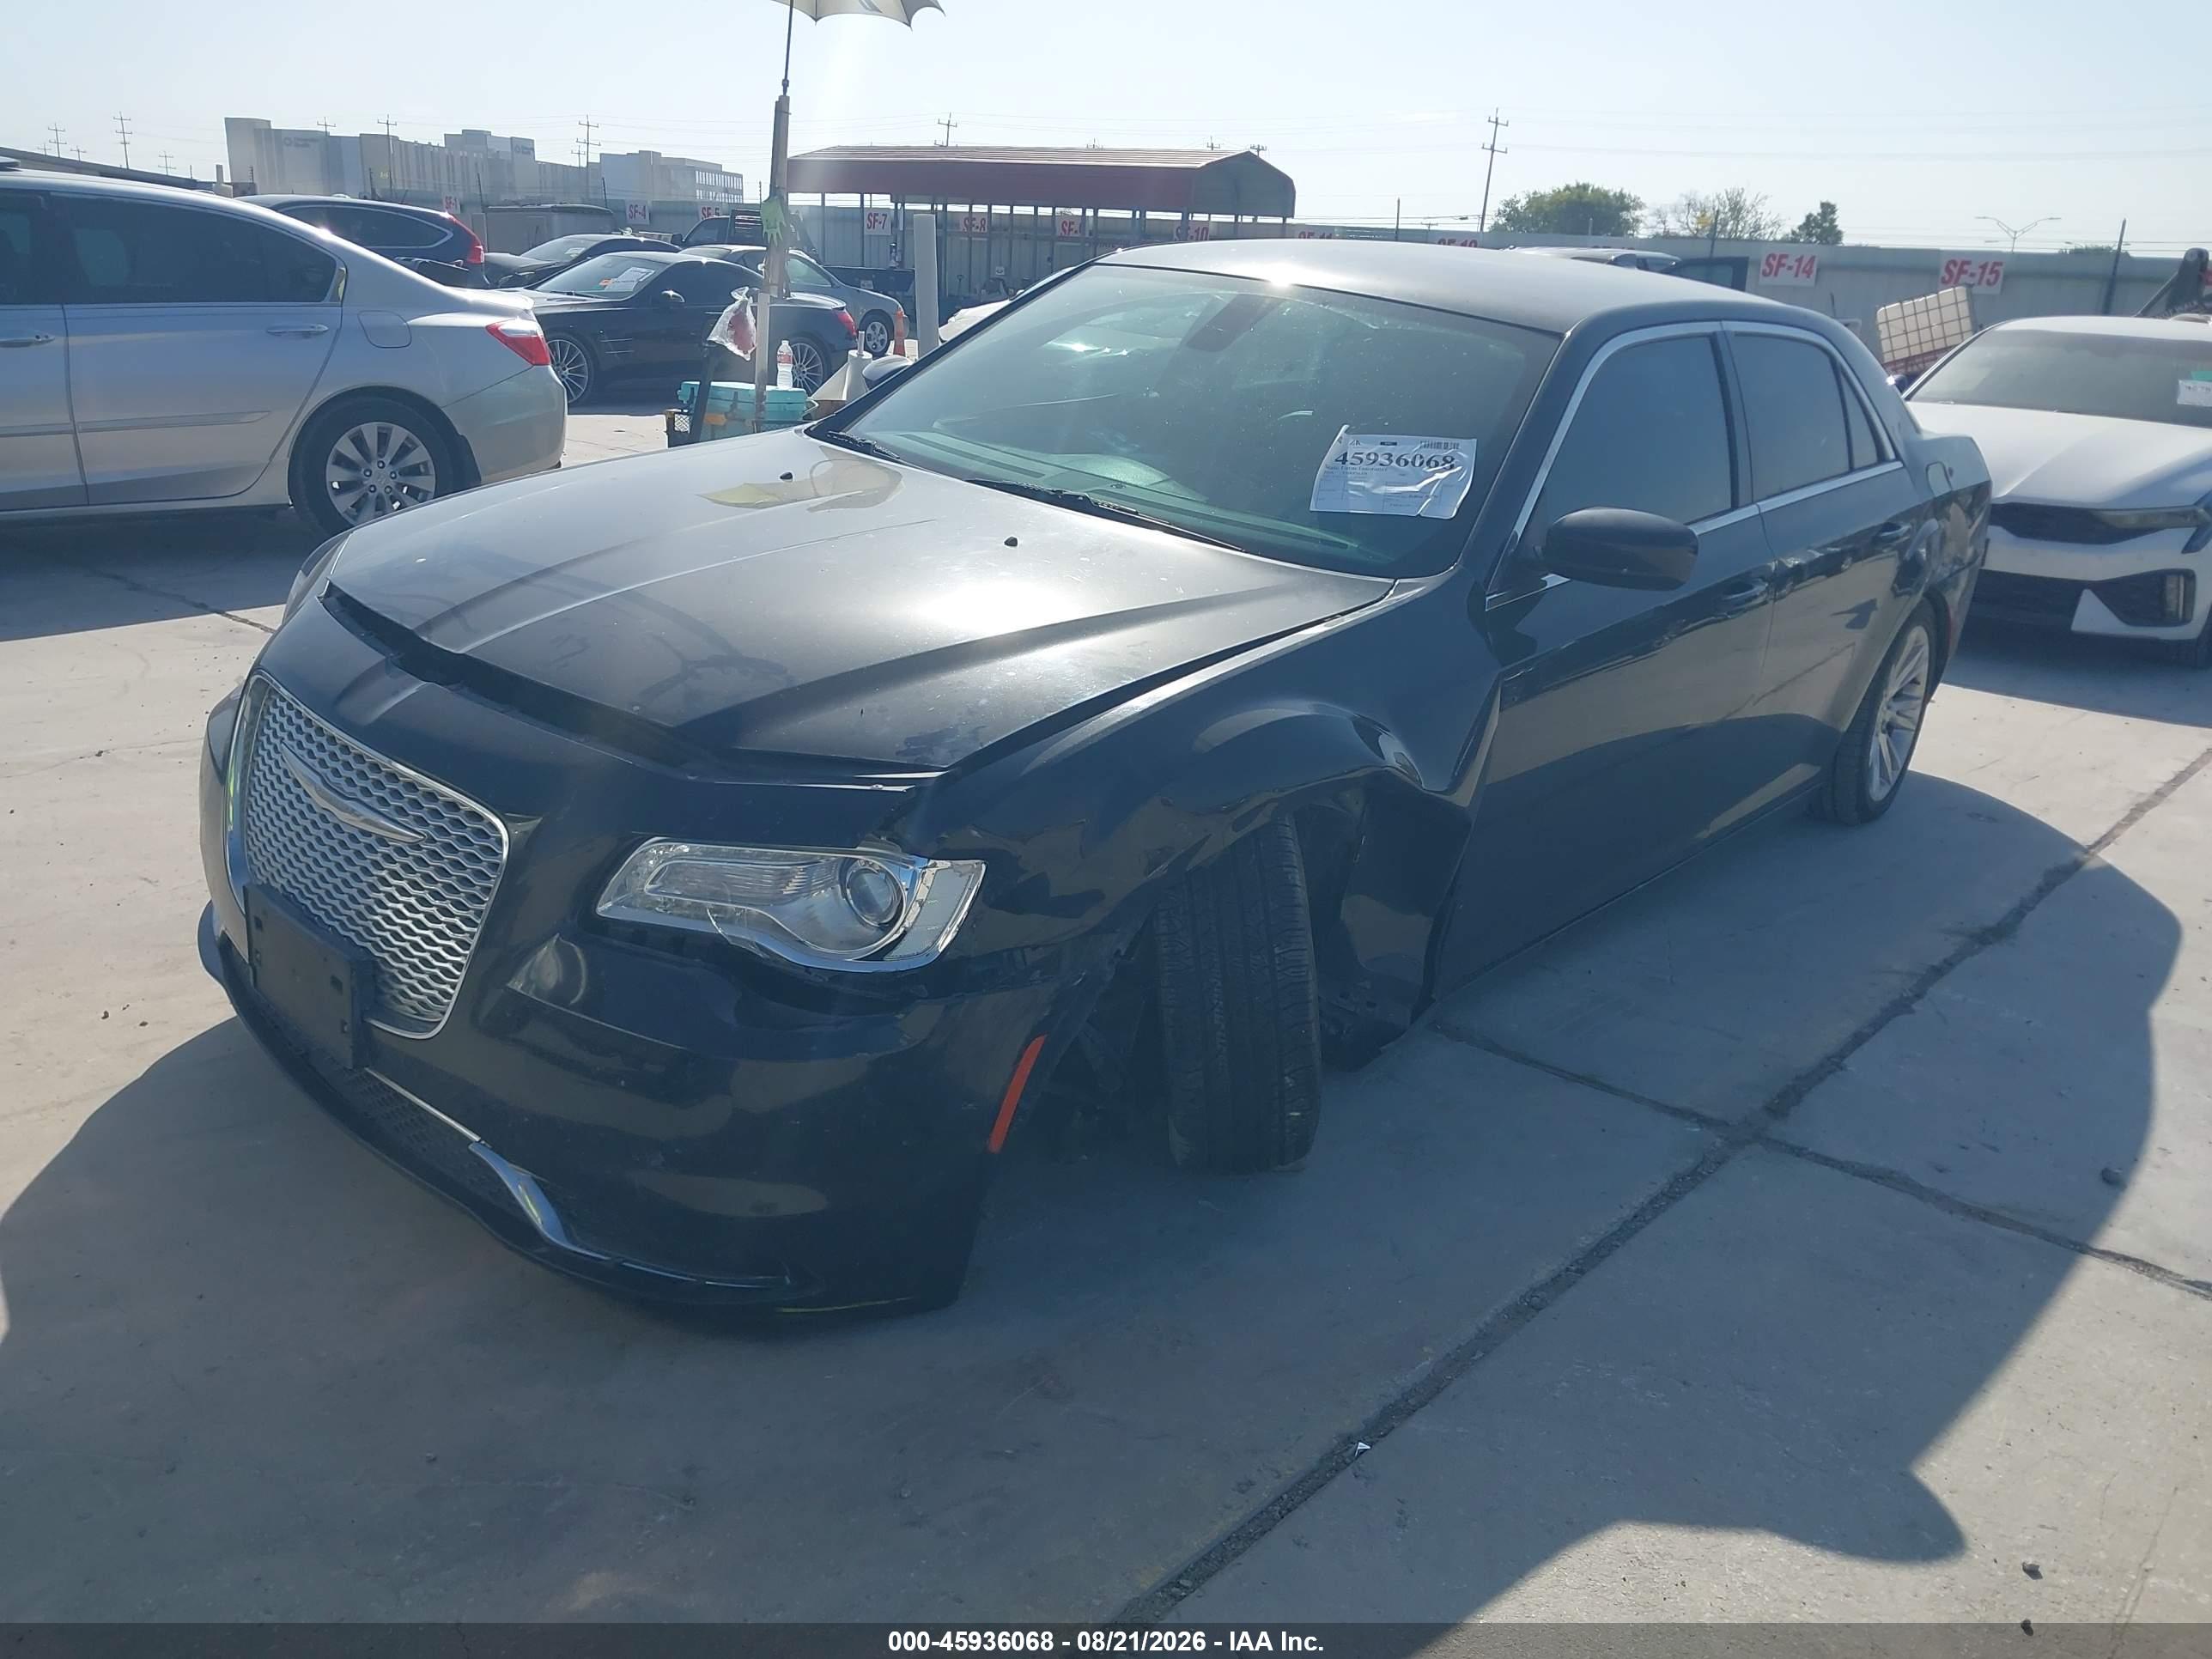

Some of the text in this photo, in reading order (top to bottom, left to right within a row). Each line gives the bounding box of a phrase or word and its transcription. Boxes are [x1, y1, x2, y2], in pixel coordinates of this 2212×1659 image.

[629, 204, 647, 220] SF-4
[866, 212, 888, 230] SF-7
[1762, 252, 1815, 278] SF-14
[1941, 259, 2003, 287] SF-15
[1334, 450, 1455, 471] 45936068
